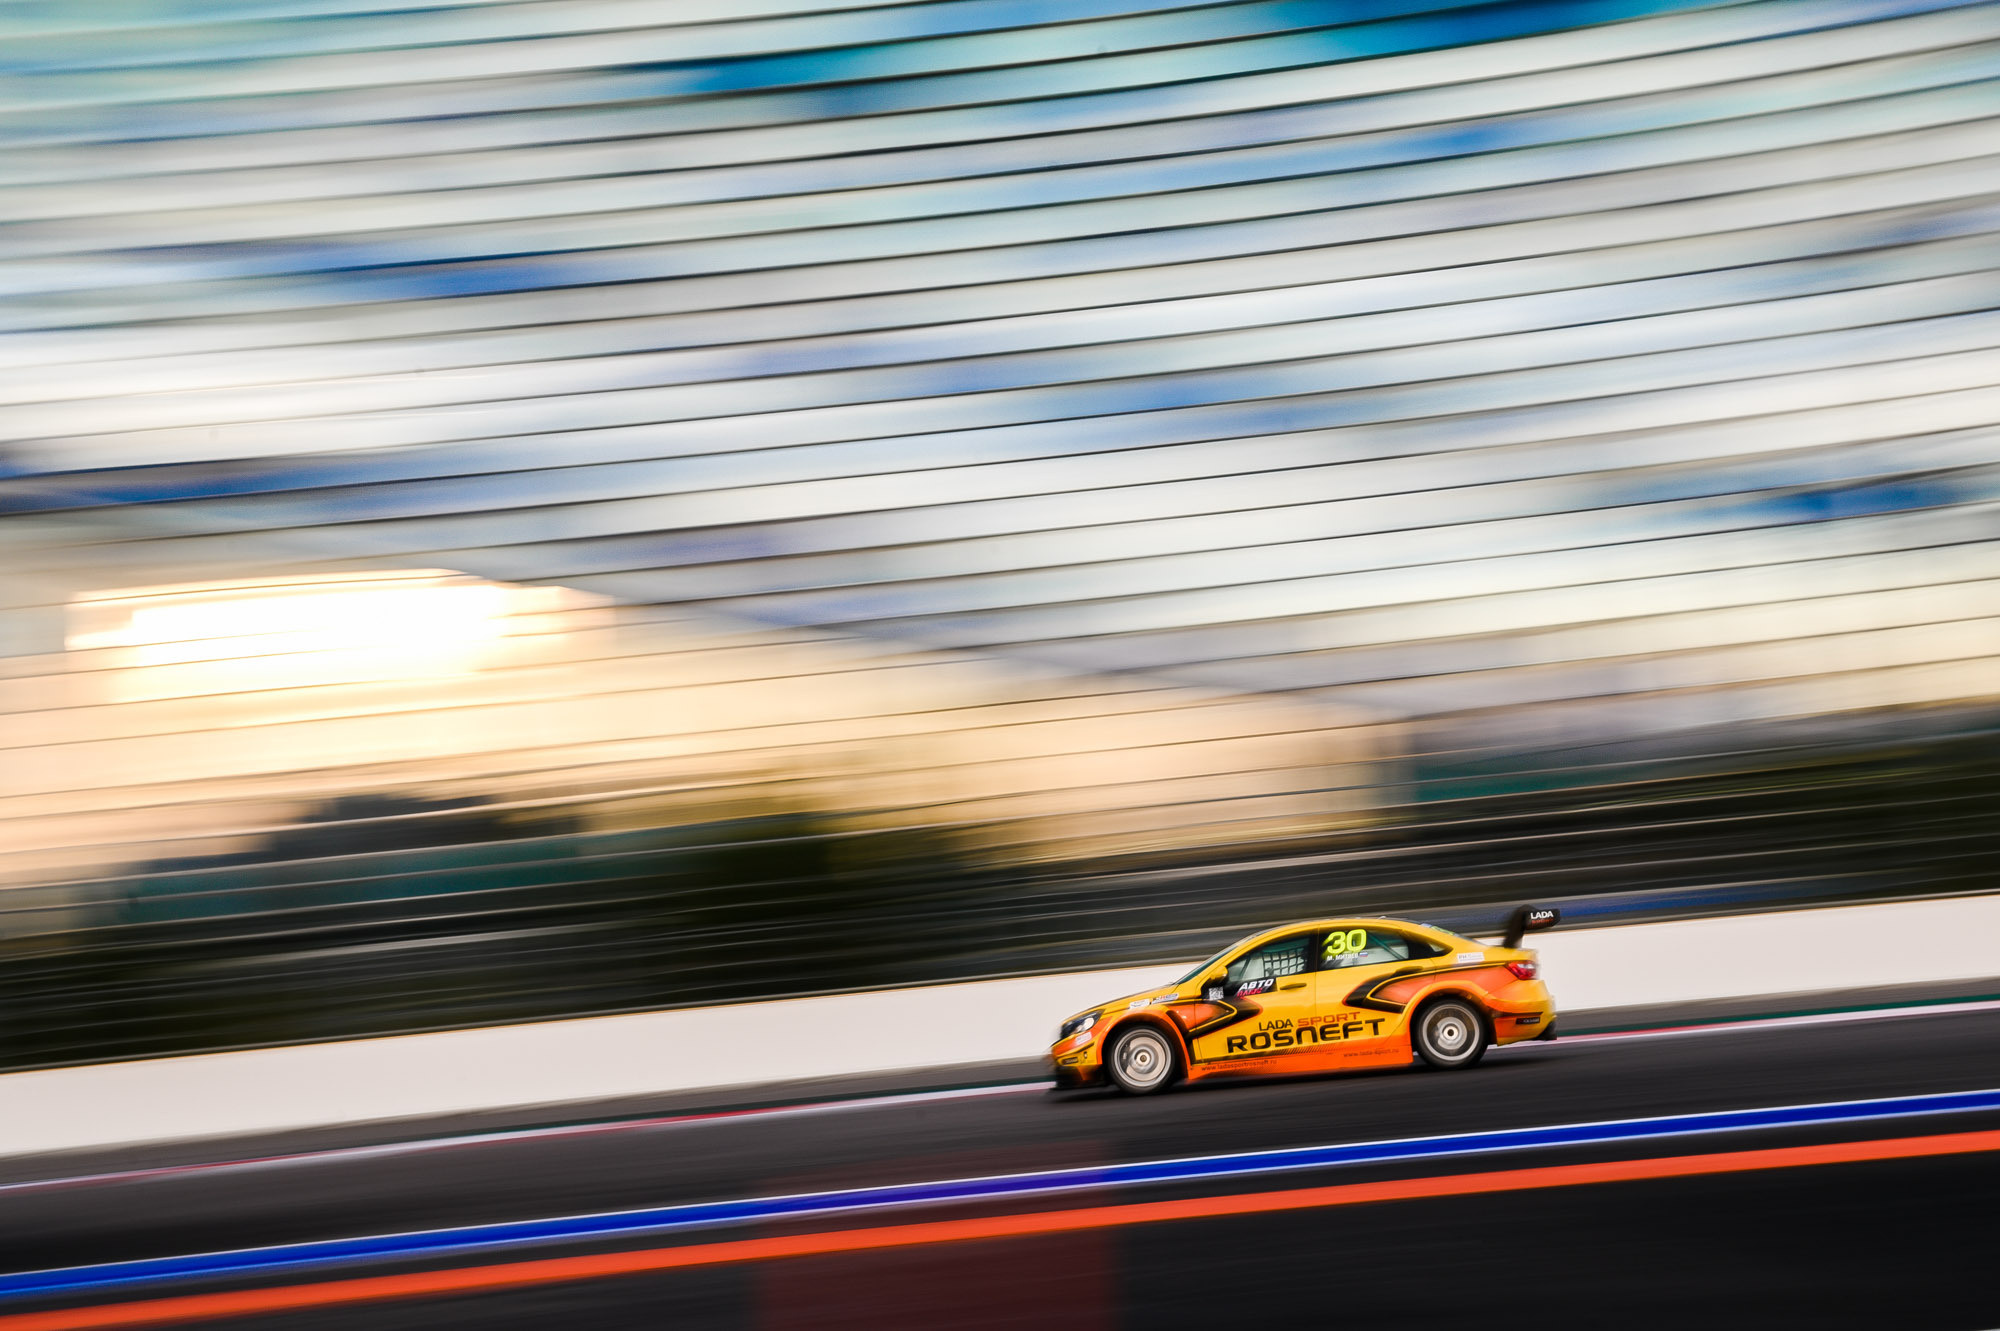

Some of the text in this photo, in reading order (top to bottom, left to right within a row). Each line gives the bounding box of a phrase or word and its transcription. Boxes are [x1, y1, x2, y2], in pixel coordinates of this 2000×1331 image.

[1530, 910, 1554, 920] LADA
[1325, 928, 1367, 954] 30
[1239, 978, 1275, 991] АВТО
[1258, 1011, 1361, 1031] LADA SPORT
[1226, 1017, 1386, 1053] ROSNEFT
